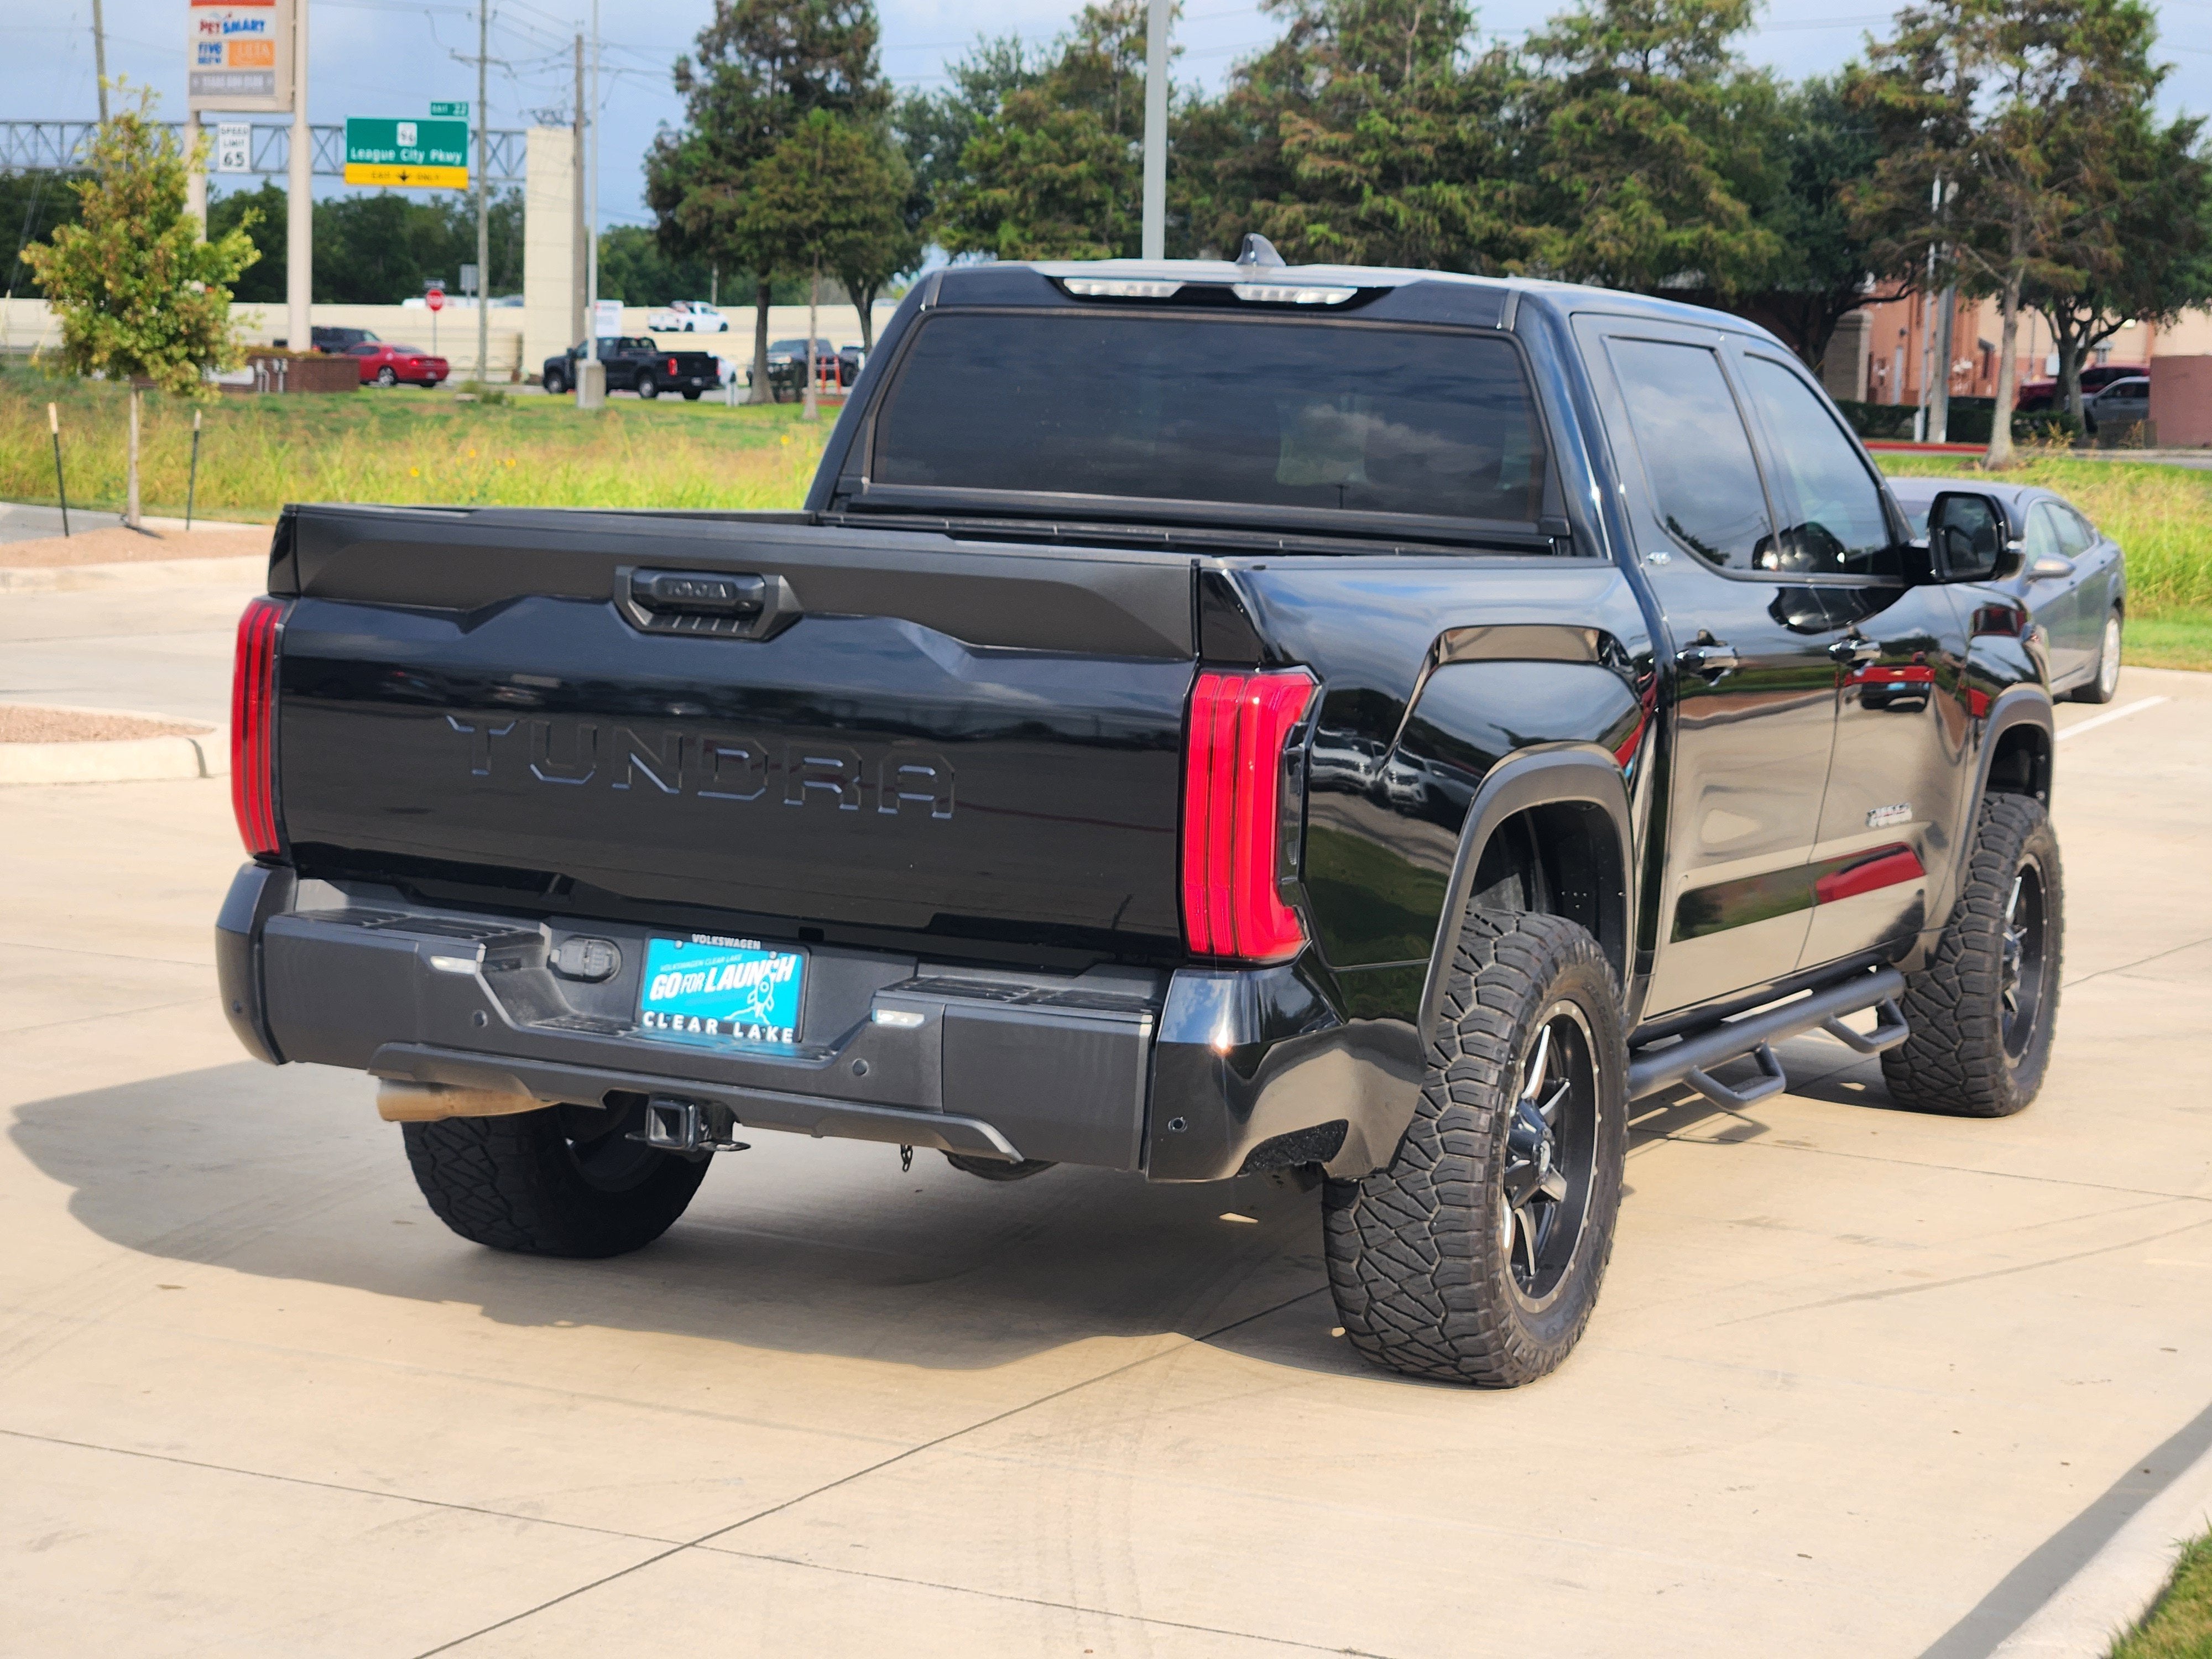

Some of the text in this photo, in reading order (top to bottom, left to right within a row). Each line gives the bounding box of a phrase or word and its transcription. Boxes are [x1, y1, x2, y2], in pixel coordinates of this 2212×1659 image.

[224, 151, 245, 167] 65
[350, 147, 462, 166] League City Pkwy
[446, 713, 956, 818] TUNDRA
[692, 933, 761, 950] VOLKSWAGEN
[705, 955, 726, 966] CLEAR
[726, 953, 743, 962] LAKE
[649, 954, 797, 1001] GO FOR LAUNCH
[642, 1010, 794, 1044] CLEAR LAKE
